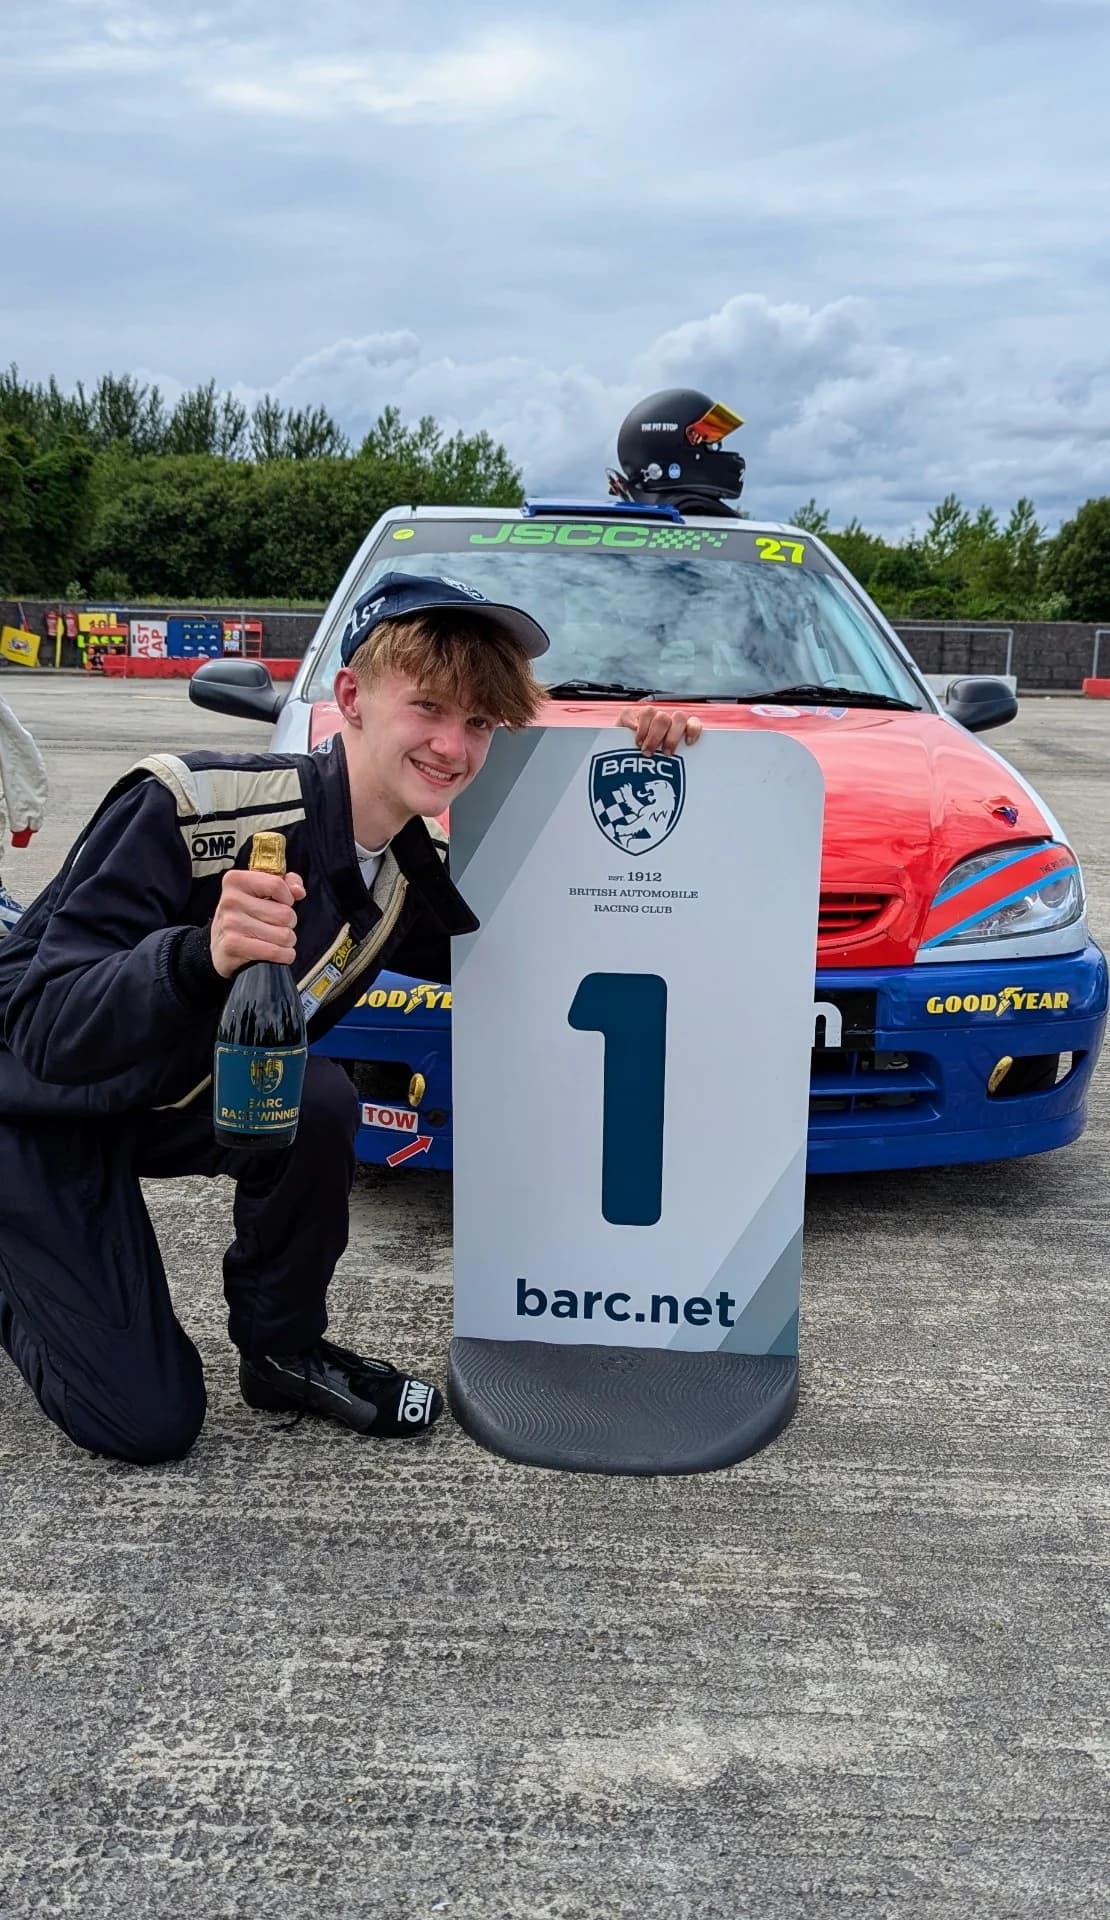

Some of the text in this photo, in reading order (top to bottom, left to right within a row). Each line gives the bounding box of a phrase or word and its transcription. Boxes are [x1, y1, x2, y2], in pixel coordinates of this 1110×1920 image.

[469, 523, 650, 547] JSCC
[755, 537, 805, 564] 27
[138, 624, 150, 657] AST
[151, 629, 163, 657] AP
[601, 757, 674, 778] BARC
[192, 836, 236, 857] OMP
[627, 871, 662, 882] 1912
[568, 887, 699, 899] BRITISH AUTOMOBILE
[594, 904, 673, 914] RACING CLUB
[567, 972, 668, 1226] 1
[365, 1106, 416, 1129] TOW
[516, 1278, 735, 1328] barc.net
[404, 1380, 430, 1423] OMP
